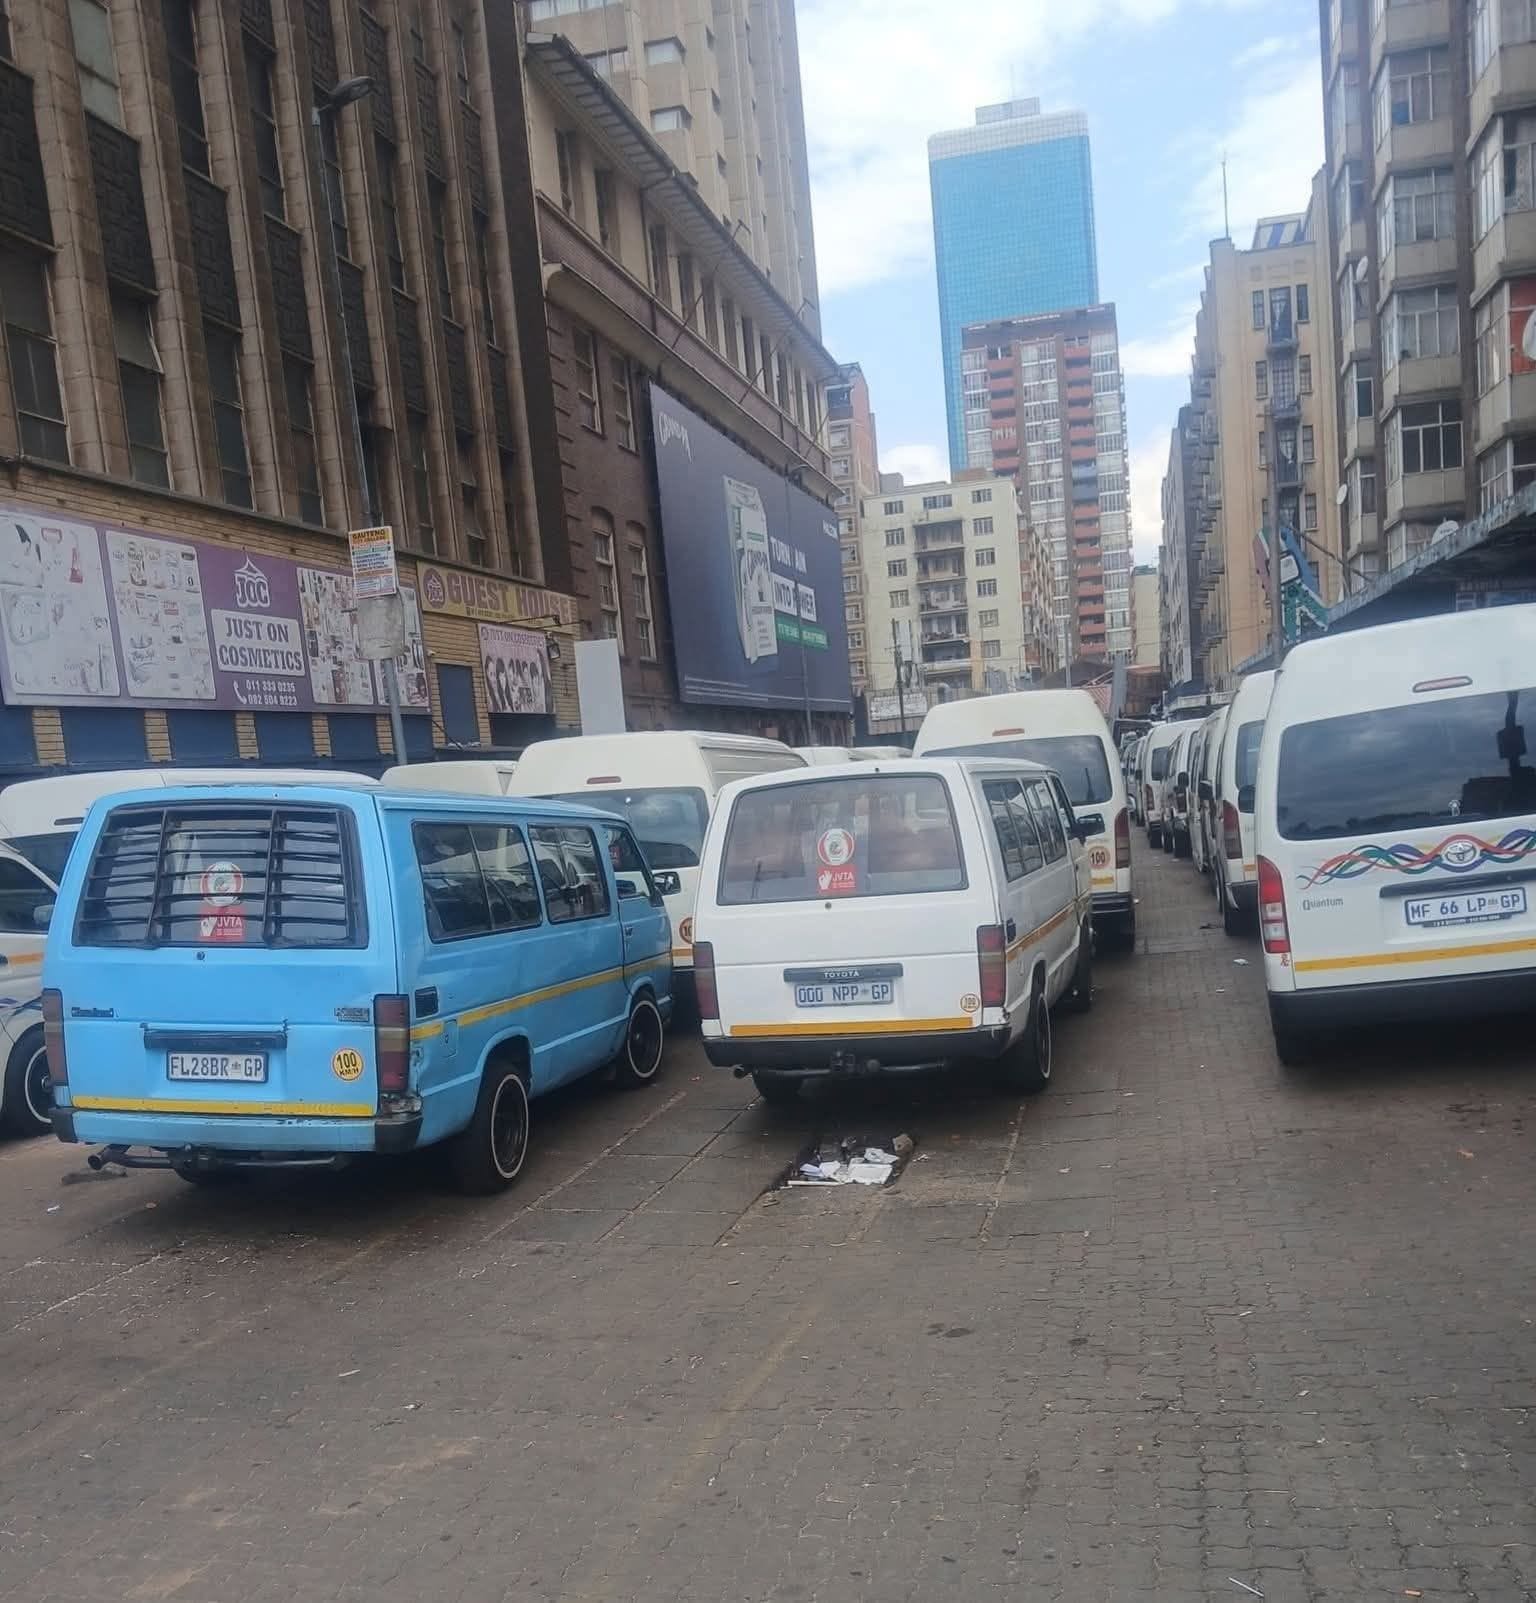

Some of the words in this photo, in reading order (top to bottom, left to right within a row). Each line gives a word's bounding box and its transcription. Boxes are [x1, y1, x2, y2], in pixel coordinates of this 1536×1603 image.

[235, 575, 270, 607] JOC
[447, 572, 508, 612] GUEST
[225, 617, 263, 640] JUST
[267, 623, 289, 643] ON
[218, 644, 302, 671] COSMETICS
[1303, 898, 1344, 911] Quantum
[1410, 903, 1430, 918] MF
[1440, 901, 1458, 915] 66
[1467, 897, 1486, 912] LP
[1500, 894, 1520, 908] GP
[824, 970, 859, 978] TOYOTA
[832, 985, 859, 1001] NPP
[871, 984, 889, 1000] GP
[170, 1056, 229, 1076] FL28BR
[244, 1058, 262, 1077] GP
[336, 1052, 357, 1069] 100
